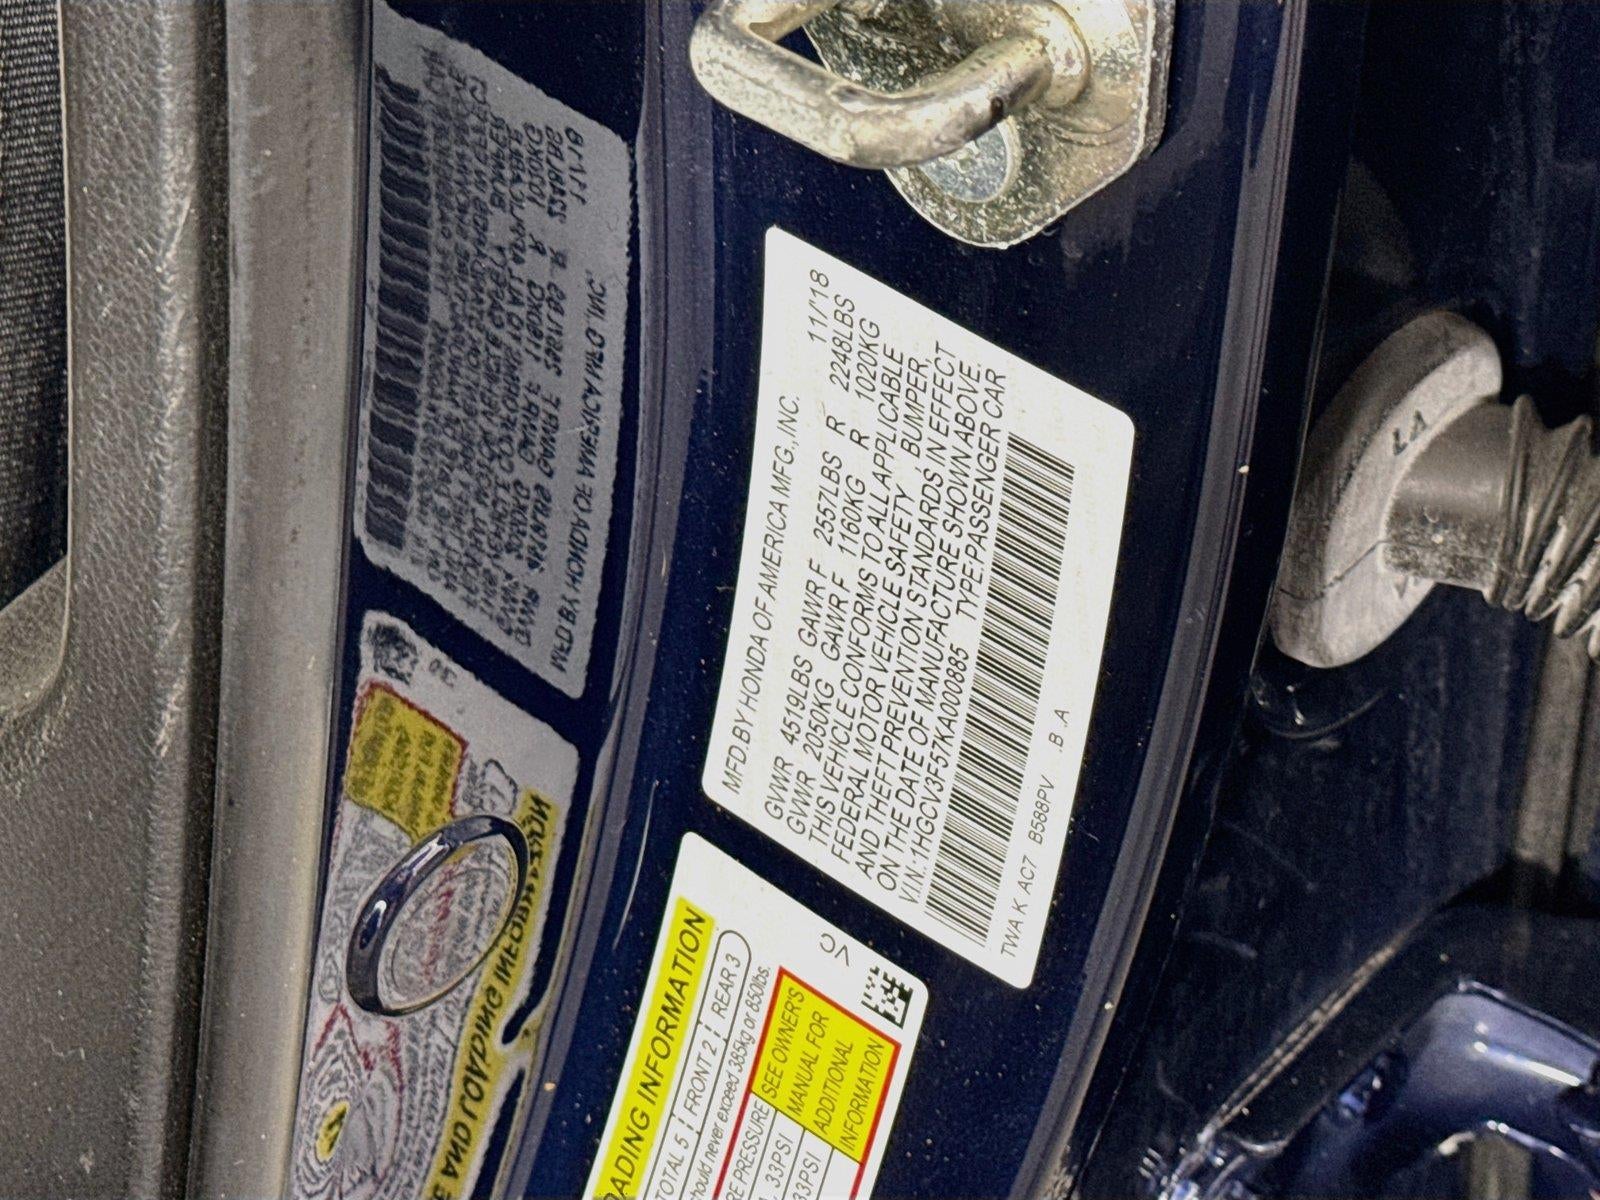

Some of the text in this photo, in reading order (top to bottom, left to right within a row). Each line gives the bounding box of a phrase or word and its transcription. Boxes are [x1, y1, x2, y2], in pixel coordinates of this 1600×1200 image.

[899, 356, 932, 459] BUMPER,
[982, 367, 1006, 419] CAR
[757, 500, 788, 601] AMERICA
[763, 293, 855, 820] GVWR 4519LBS GAWR F 2557LBS R 2248LBS
[785, 317, 880, 835] GVWR 2050KG GAWR F 1160KG R 1020KG
[884, 482, 915, 577] SAFETY
[751, 595, 773, 631] OF
[807, 342, 904, 846] THIS VEHICLE CONFORMS TO ALL APPLICABLE
[854, 340, 956, 880] AND THEFT PREVENTION STANDARDS IN EFFECT
[868, 576, 903, 674] VEHICLE
[876, 359, 981, 891] ON THE DATE OF MANUFACTURE SHOWN ABOVE.
[738, 634, 769, 712] HONDA
[852, 676, 886, 763] MOTOR
[830, 765, 870, 864] FEDERAL
[1027, 774, 1054, 845] B588PV
[1011, 897, 1028, 915] K
[1017, 854, 1036, 895] AC7
[710, 952, 741, 1019] REAR 3
[1000, 919, 1023, 957] TWA
[636, 906, 706, 1106] INFORMATION
[760, 986, 804, 1099] SEE OWNER'S
[682, 1039, 717, 1117] FRONT 2
[689, 965, 771, 1200] hould never exceed 385kg or 850lbs.
[786, 1010, 829, 1116] MANUAL FOR
[812, 1040, 853, 1135] ADDITIONAL
[839, 1037, 884, 1151] INFORMATION
[673, 1133, 689, 1150] 5
[732, 1099, 770, 1185] PRESSURE
[764, 1132, 793, 1188] 33PSI
